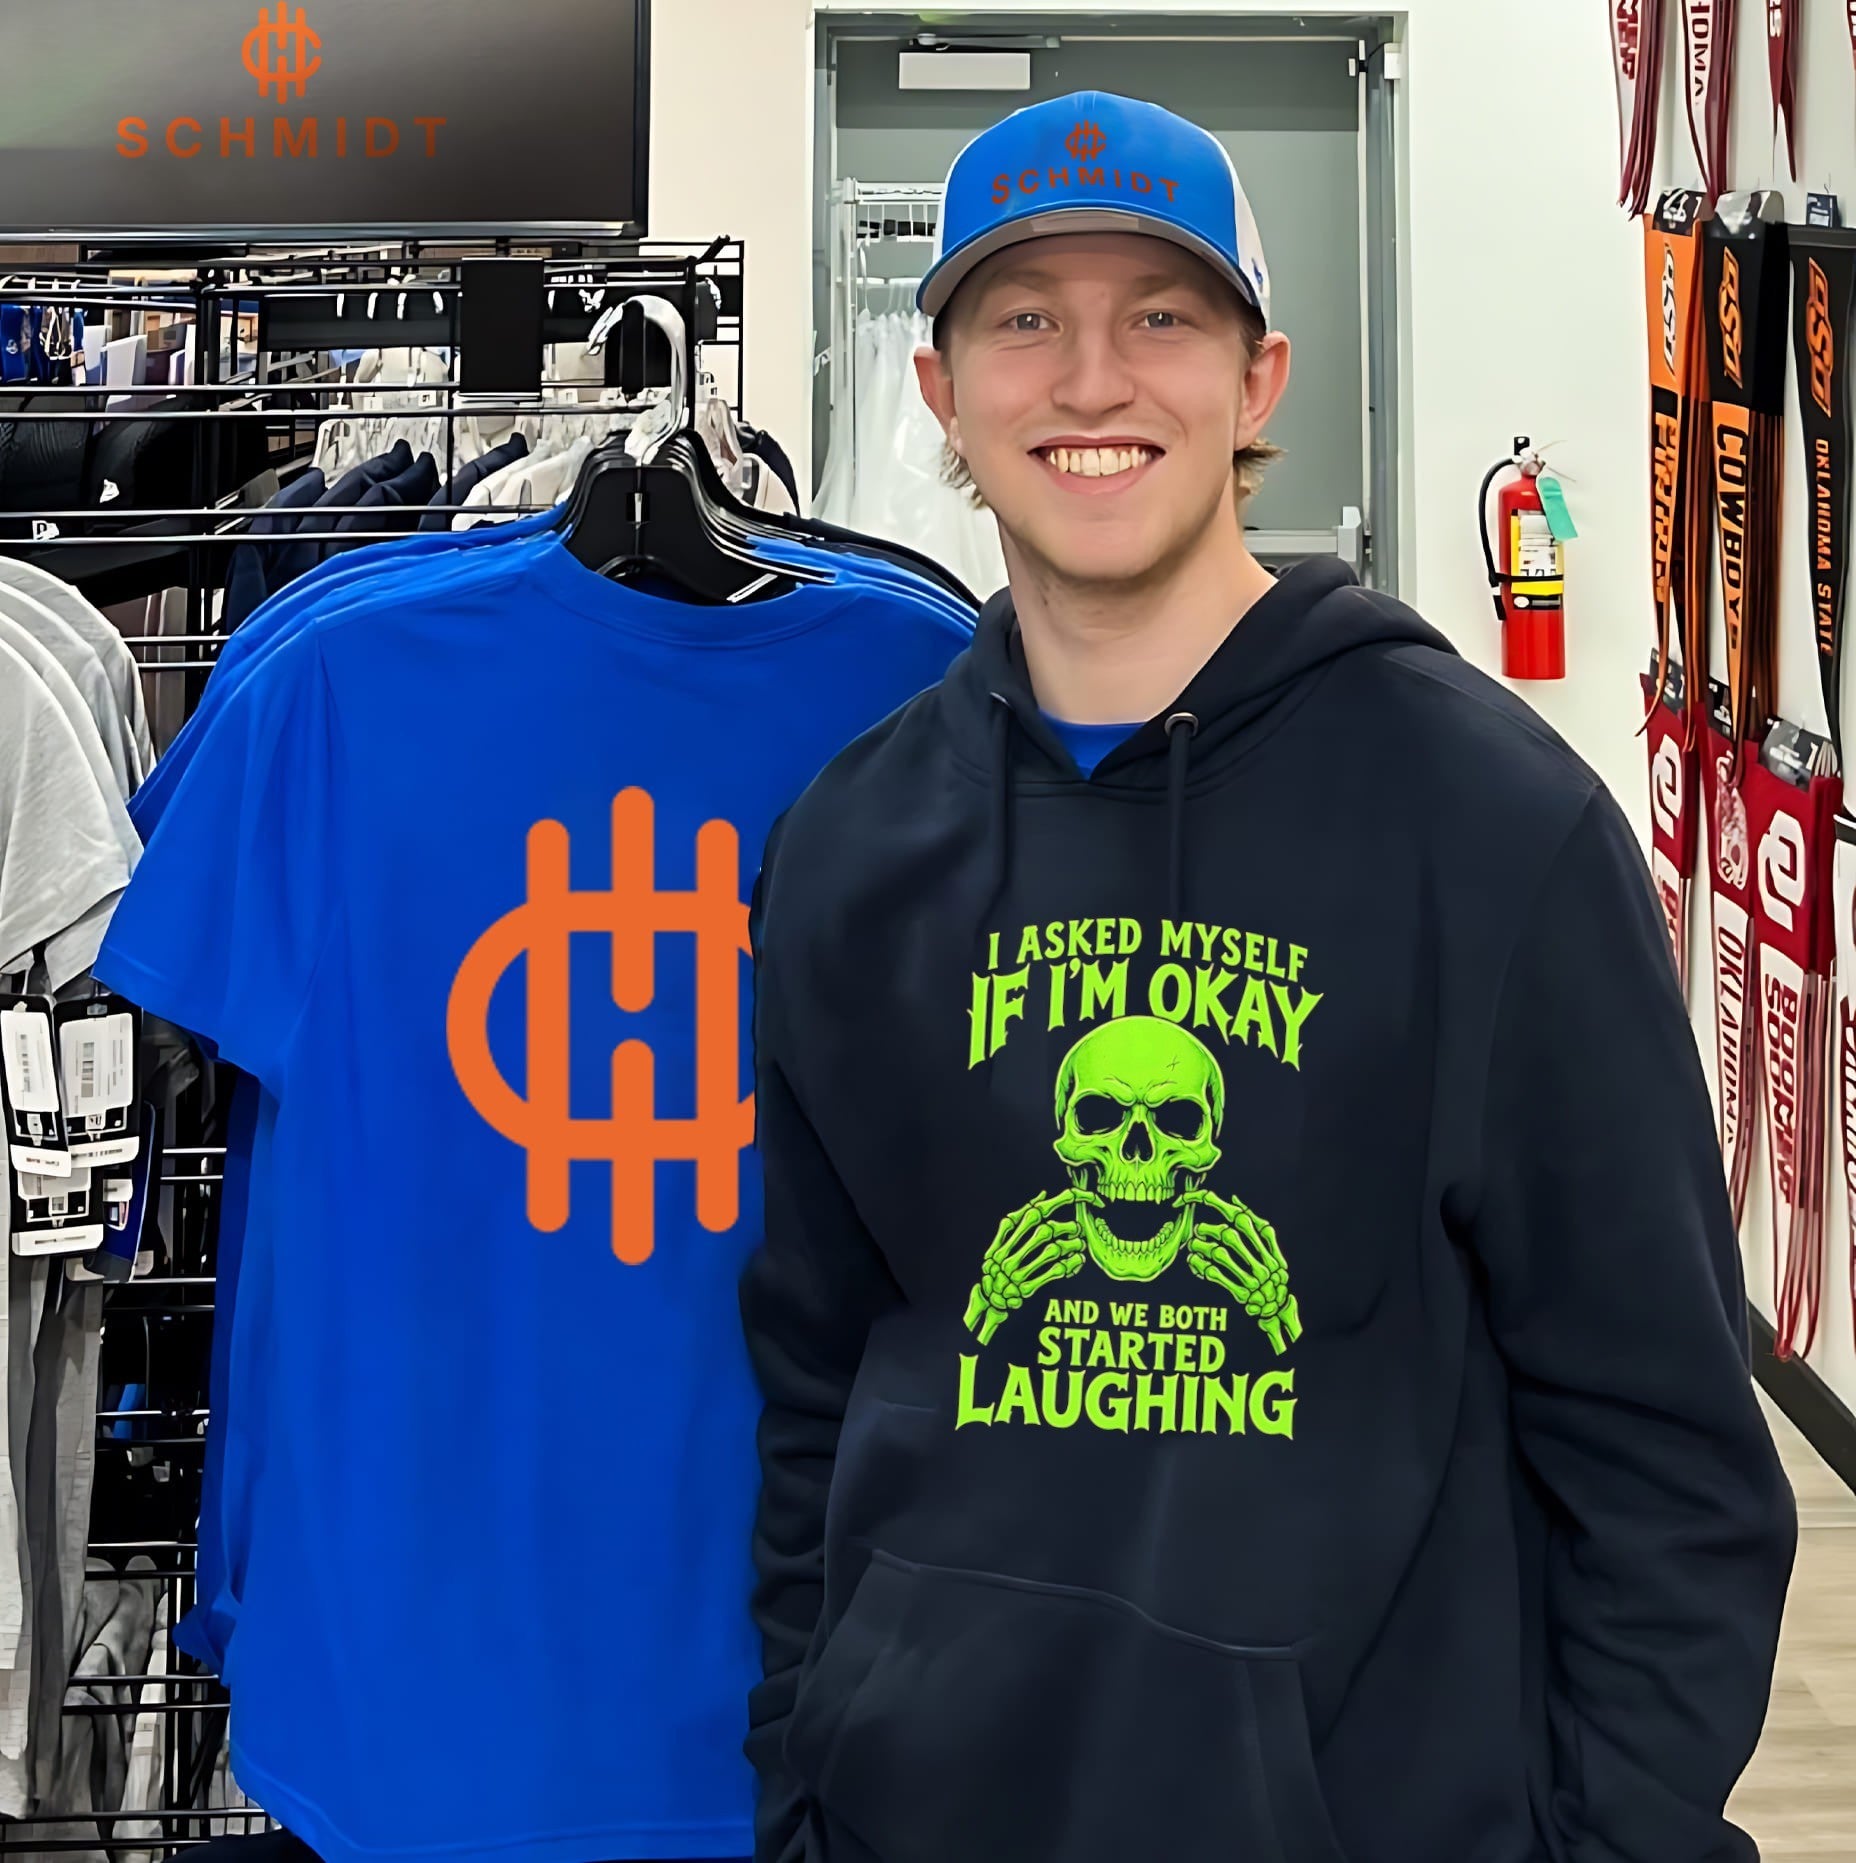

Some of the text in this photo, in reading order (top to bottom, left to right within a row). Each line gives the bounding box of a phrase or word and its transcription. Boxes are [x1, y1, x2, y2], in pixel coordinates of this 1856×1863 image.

[116, 116, 447, 159] SCHMIDT
[991, 167, 1180, 204] SCHMIDT
[1815, 438, 1832, 570] OKLAHOMA
[987, 917, 1309, 983] I ASKED MYSELF
[966, 956, 1325, 1072] IF I'M OKAY
[1043, 1298, 1228, 1332] AND WE BOTH
[1037, 1325, 1226, 1374] STARTED
[955, 1353, 1298, 1440] LAUGHING
